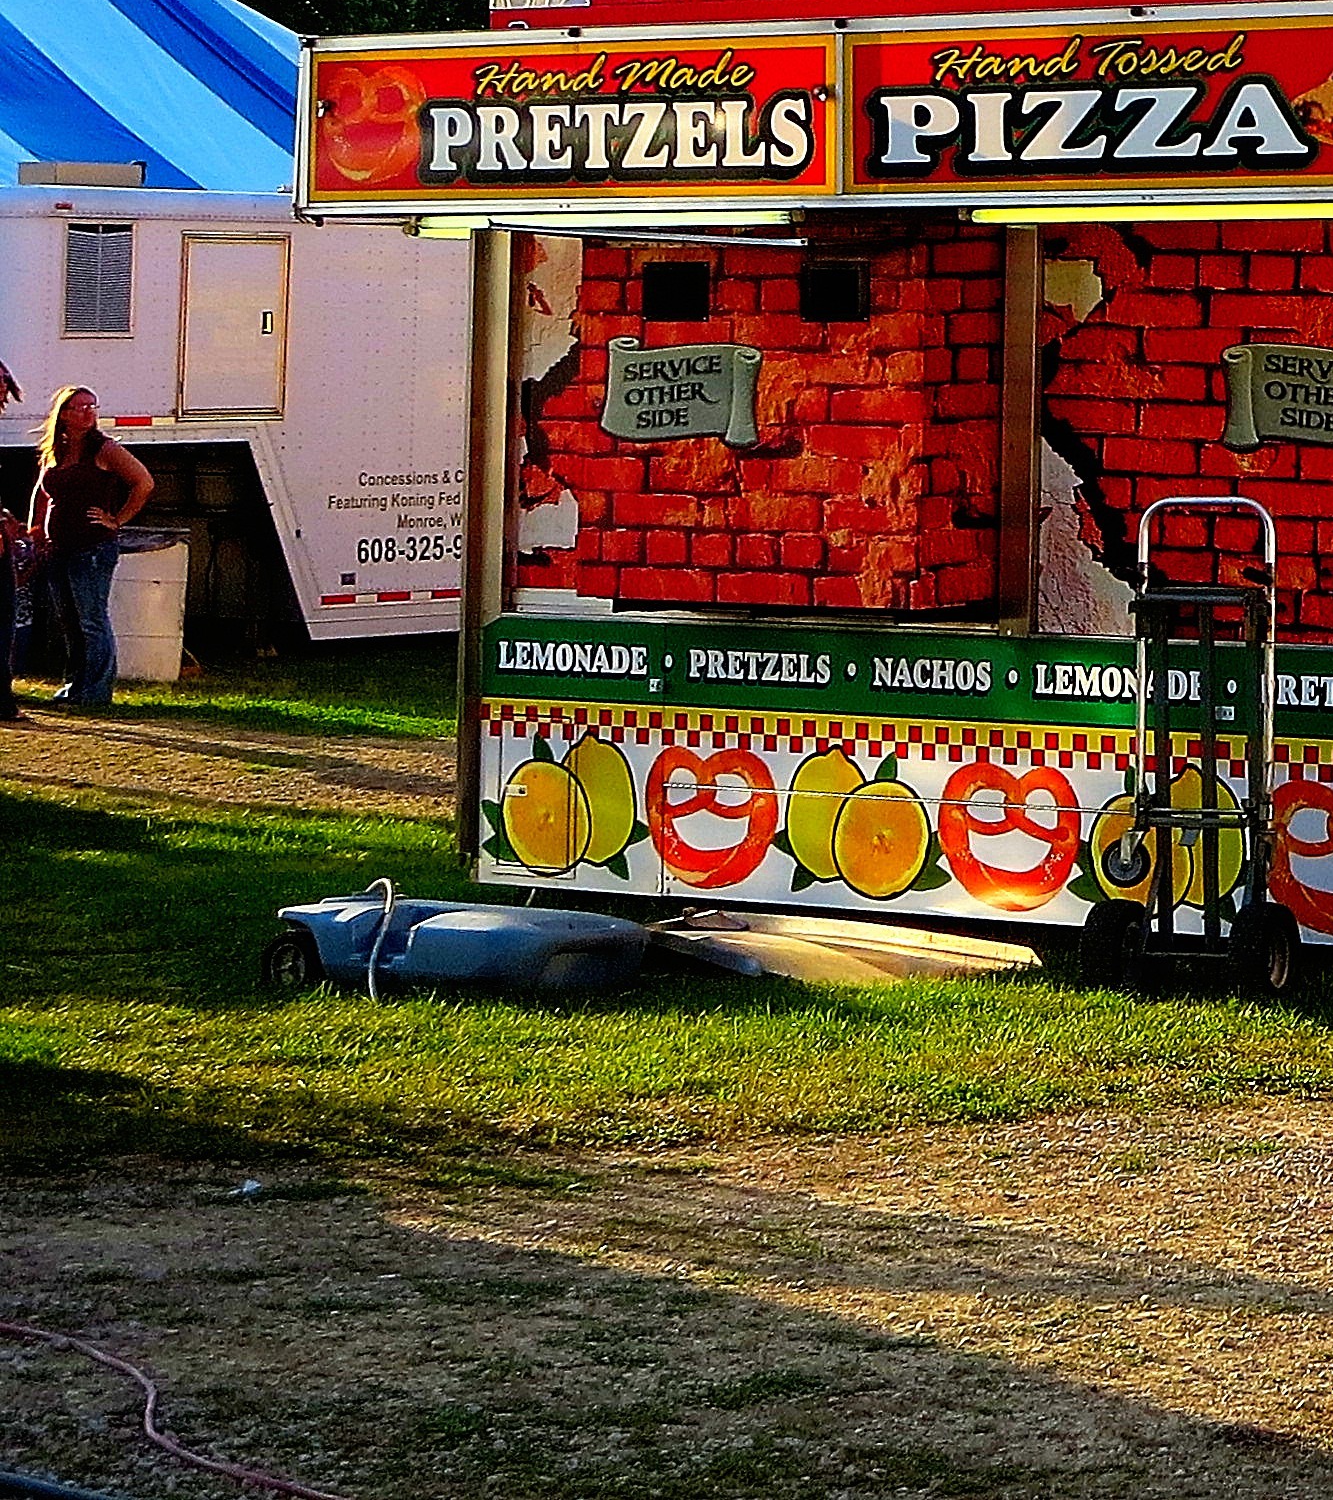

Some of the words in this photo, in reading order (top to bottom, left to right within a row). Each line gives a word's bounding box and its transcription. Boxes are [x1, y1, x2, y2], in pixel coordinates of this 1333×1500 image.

[475, 51, 605, 94] Hand
[617, 49, 754, 90] Made
[935, 39, 1075, 81] Hand
[1094, 34, 1246, 74] Tossed
[429, 98, 808, 171] PRETZELS
[880, 85, 1310, 163] PIZZA
[623, 354, 722, 382] SERVICE
[625, 381, 718, 406] OTHER
[636, 407, 690, 430] SIDE
[359, 471, 438, 486] Concessions
[443, 470, 451, 484] &
[328, 494, 388, 511] Featuring
[391, 493, 435, 510] Koning
[397, 513, 447, 529] Monroe,
[499, 642, 648, 676] LEMONADE
[689, 649, 831, 684] PRETZELS
[872, 657, 992, 691] NACHOS
[1034, 664, 1201, 701] LEMONDE
